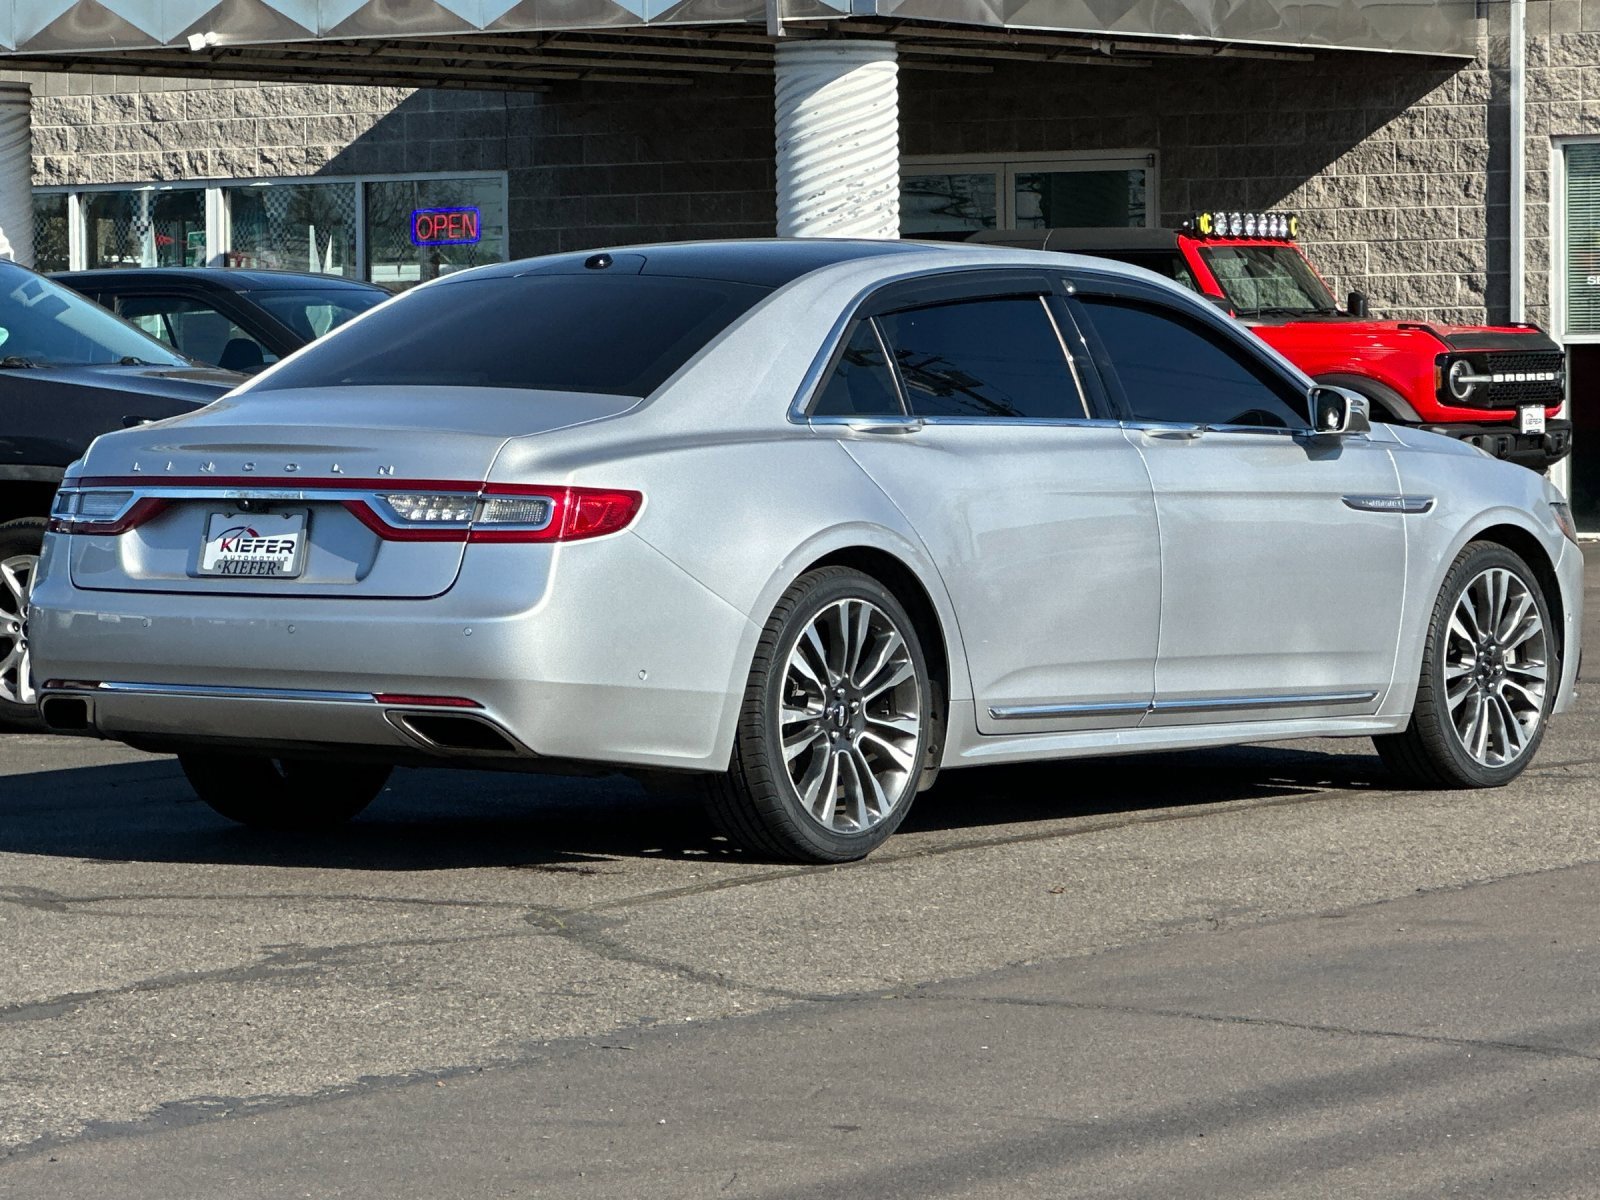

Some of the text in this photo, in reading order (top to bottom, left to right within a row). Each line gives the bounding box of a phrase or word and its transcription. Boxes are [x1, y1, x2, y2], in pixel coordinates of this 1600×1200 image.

[416, 213, 477, 240] OPEN
[1586, 275, 1600, 285] S
[1493, 372, 1554, 383] BRONCO
[132, 460, 396, 476] LINCOLN
[220, 537, 296, 555] KIEFER
[222, 554, 289, 563] AUTOMOTIVE
[220, 560, 278, 576] KIEFER
